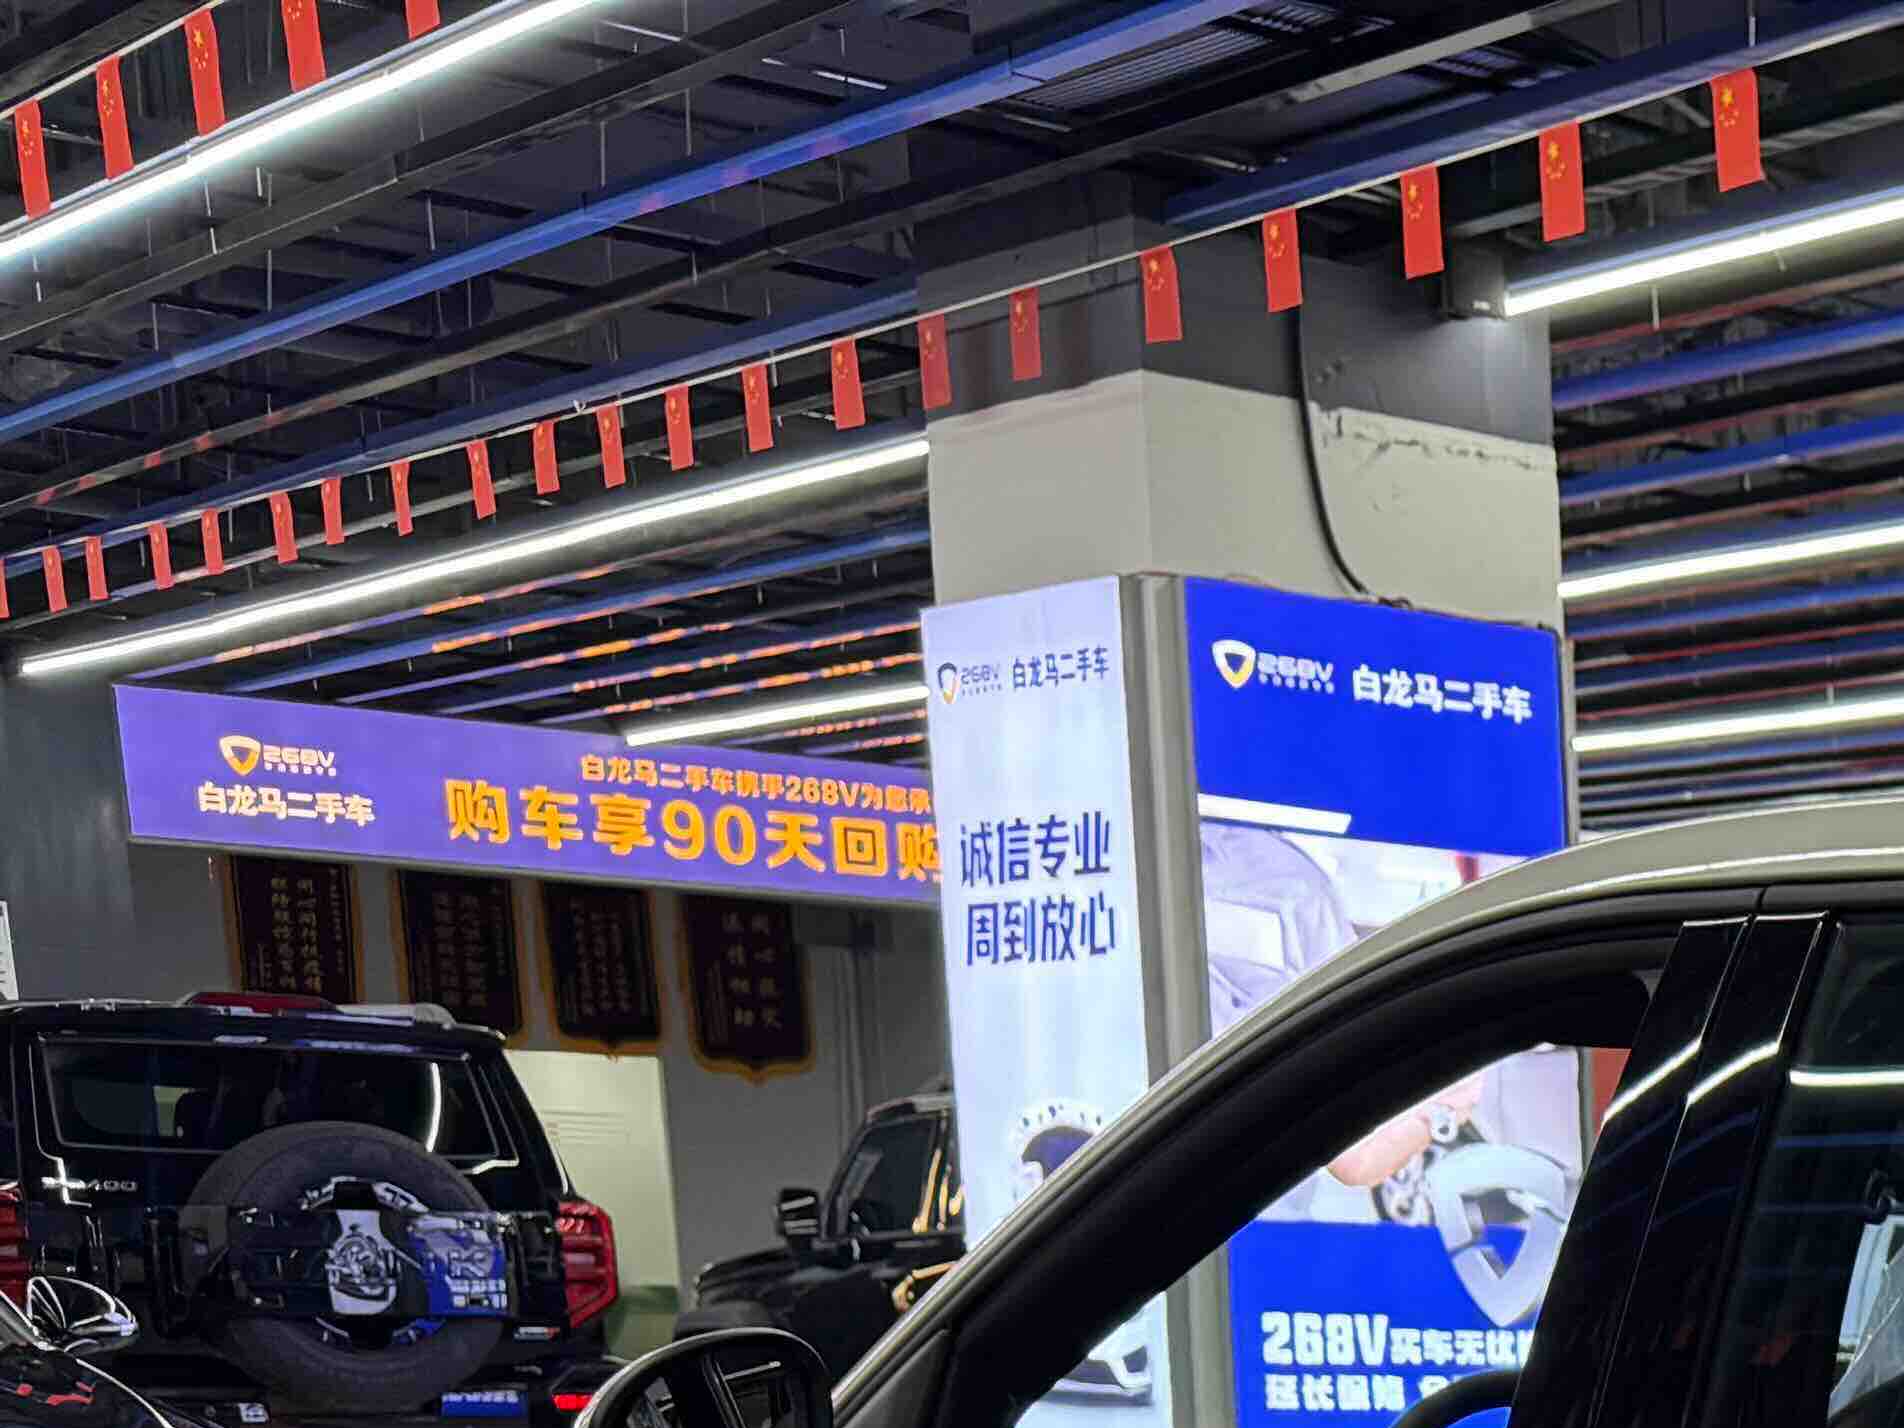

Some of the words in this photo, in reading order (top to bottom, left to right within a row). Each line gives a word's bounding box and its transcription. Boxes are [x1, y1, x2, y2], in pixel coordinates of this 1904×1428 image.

[1013, 645, 1109, 689] 白龙马二手车
[1352, 664, 1533, 724] 白龙马二手车
[198, 781, 376, 826] 白龙马二手车
[961, 811, 1110, 887] 诚信专业
[967, 890, 1115, 966] 周到放心
